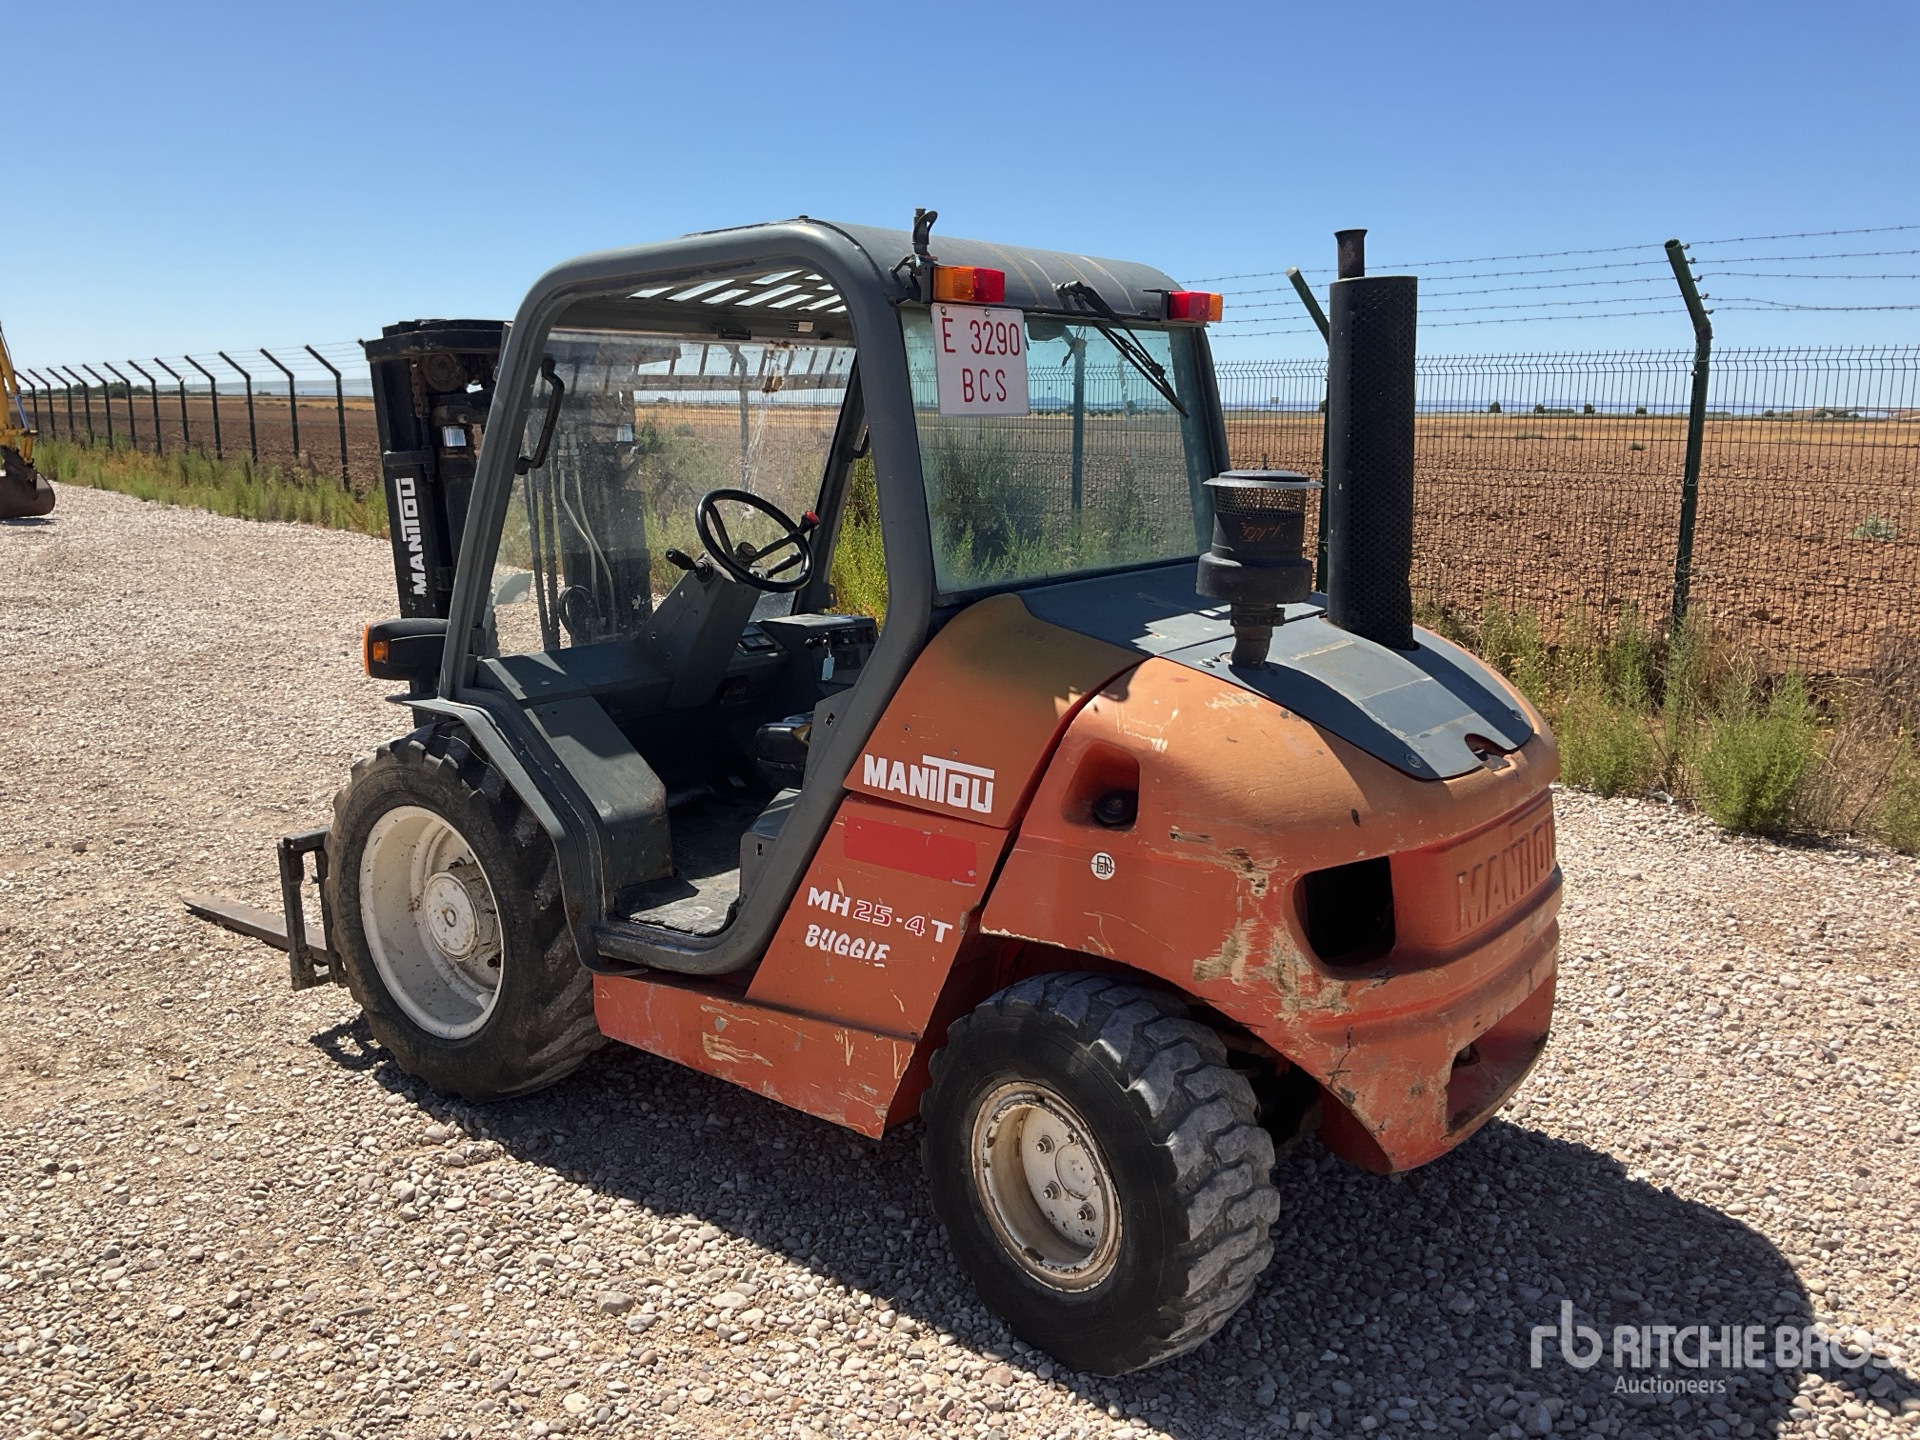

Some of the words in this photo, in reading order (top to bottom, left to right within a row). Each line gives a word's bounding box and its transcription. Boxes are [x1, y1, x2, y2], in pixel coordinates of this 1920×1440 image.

[942, 317, 956, 353] E
[969, 320, 1020, 356] 3290
[962, 368, 1007, 402] BCS
[395, 477, 428, 595] MANITOU
[863, 754, 995, 813] MANITOU
[805, 924, 891, 967] BUGGIE
